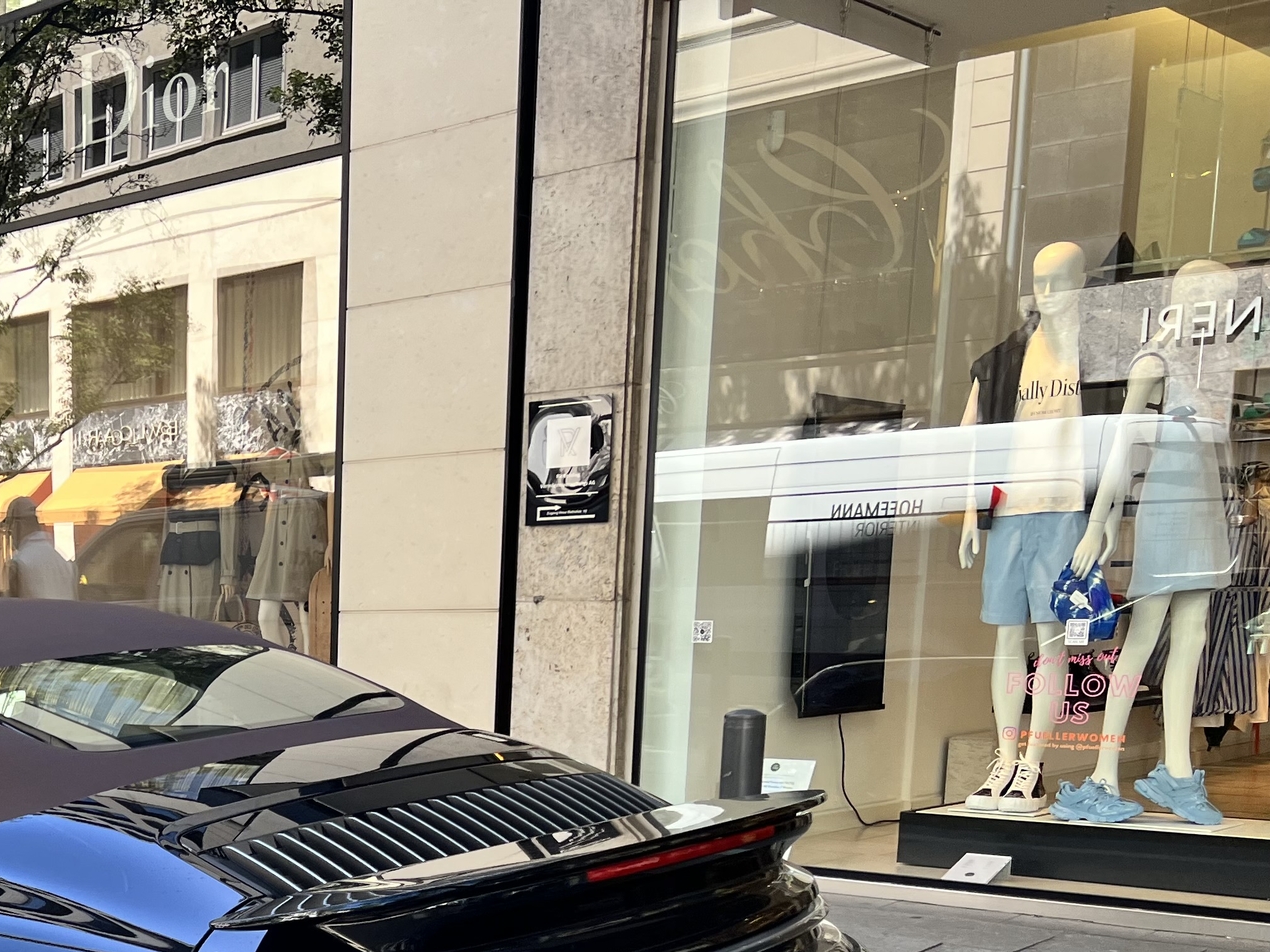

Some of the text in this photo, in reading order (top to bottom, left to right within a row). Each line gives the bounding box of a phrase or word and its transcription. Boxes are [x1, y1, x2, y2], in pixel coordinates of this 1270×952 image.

[71, 46, 229, 151] Dior
[1018, 378, 1081, 405] ially Dist
[1006, 672, 1142, 698] FOLLOW
[1049, 701, 1090, 725] US
[1020, 730, 1126, 744] PFUELLERWOMEN
